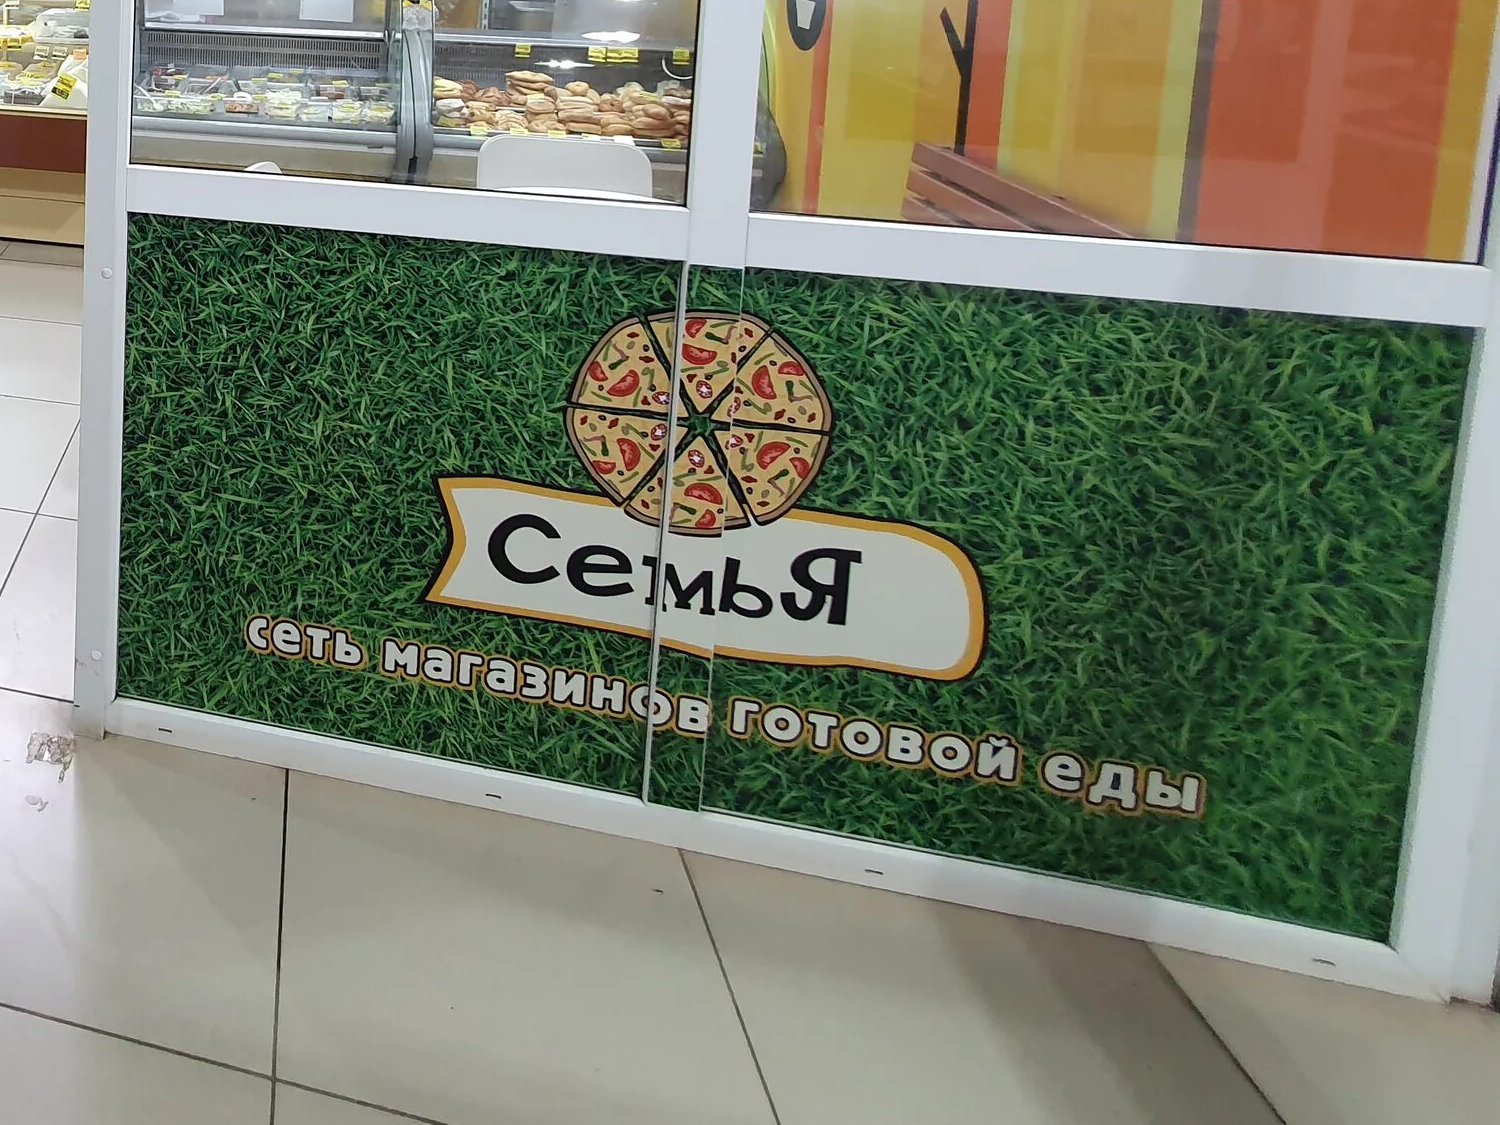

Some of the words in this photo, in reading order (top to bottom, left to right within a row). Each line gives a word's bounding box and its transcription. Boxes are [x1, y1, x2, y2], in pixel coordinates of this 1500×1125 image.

[244, 614, 363, 667] сеть
[382, 639, 713, 735] магазинов
[729, 700, 1020, 782] готовой
[1042, 754, 1204, 815] еды
